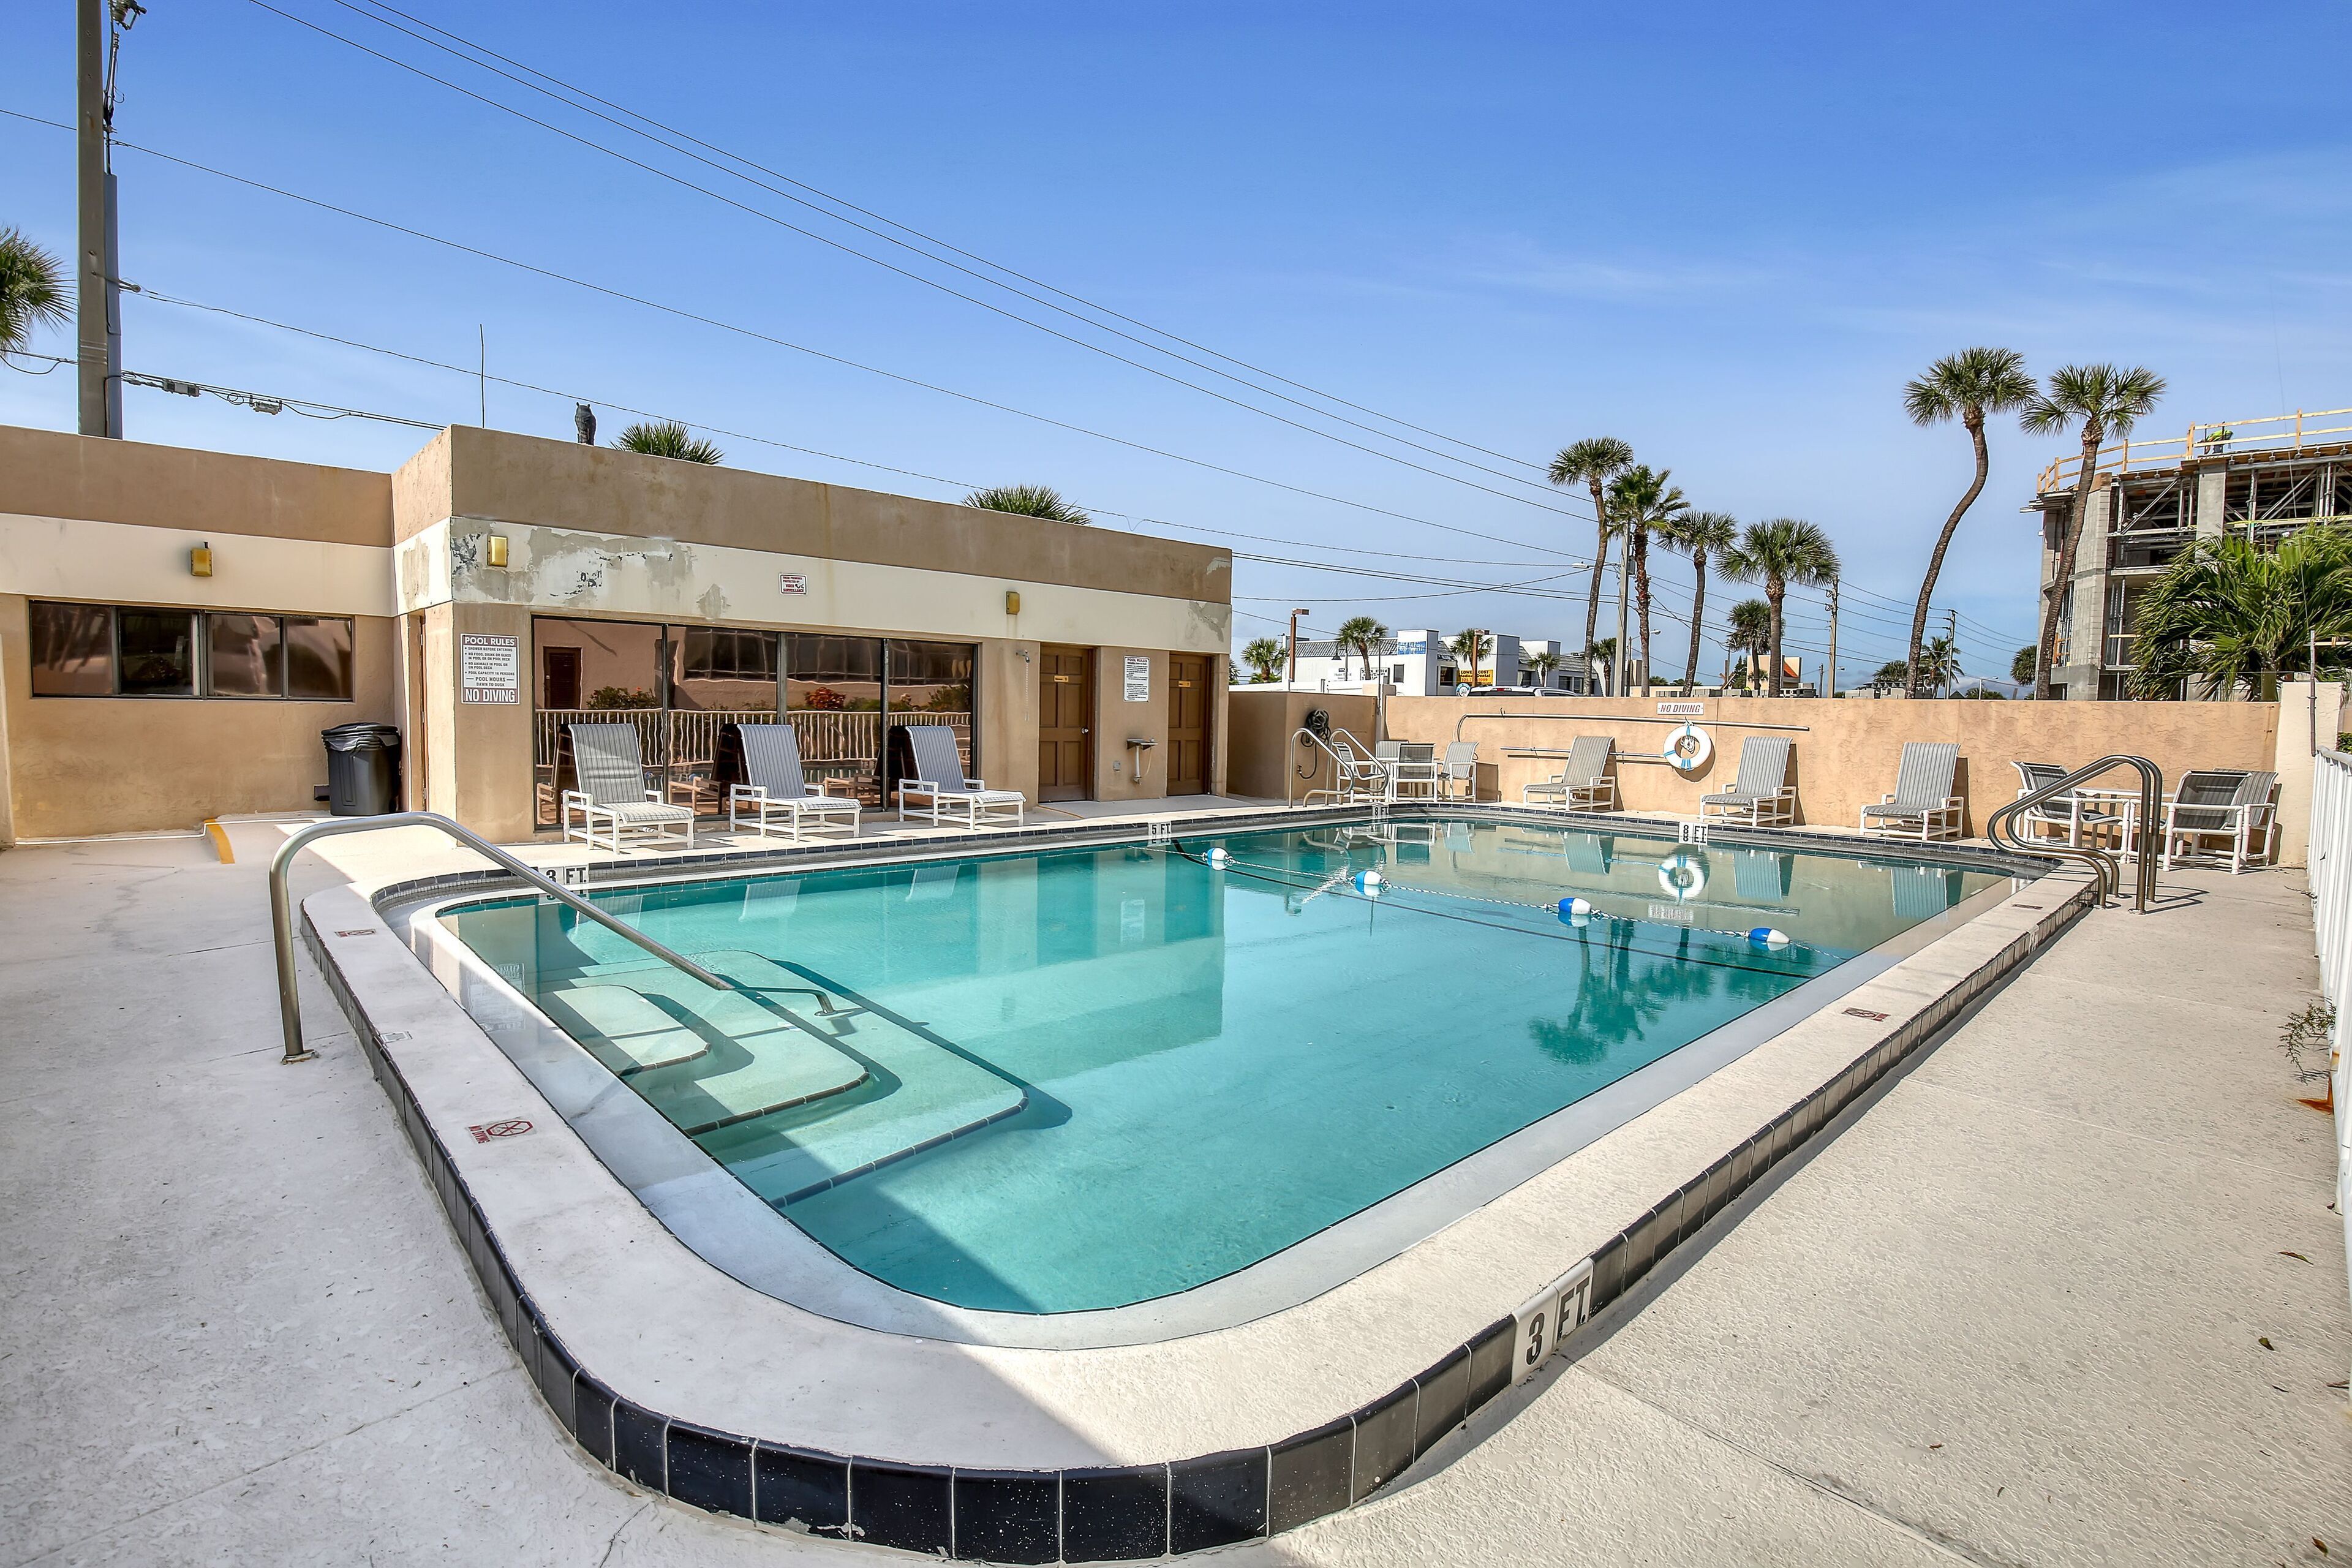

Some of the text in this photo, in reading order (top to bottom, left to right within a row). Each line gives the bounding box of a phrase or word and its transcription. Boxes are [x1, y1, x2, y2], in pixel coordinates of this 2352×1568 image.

[491, 638, 514, 646] RULES
[466, 689, 514, 702] NO DIVING
[1375, 807, 1378, 815] 8
[1152, 824, 1157, 834] 5
[1684, 824, 1706, 835] 8 FT.
[546, 867, 587, 883] 3 FT.
[1526, 1275, 1590, 1365] 3 FT.
